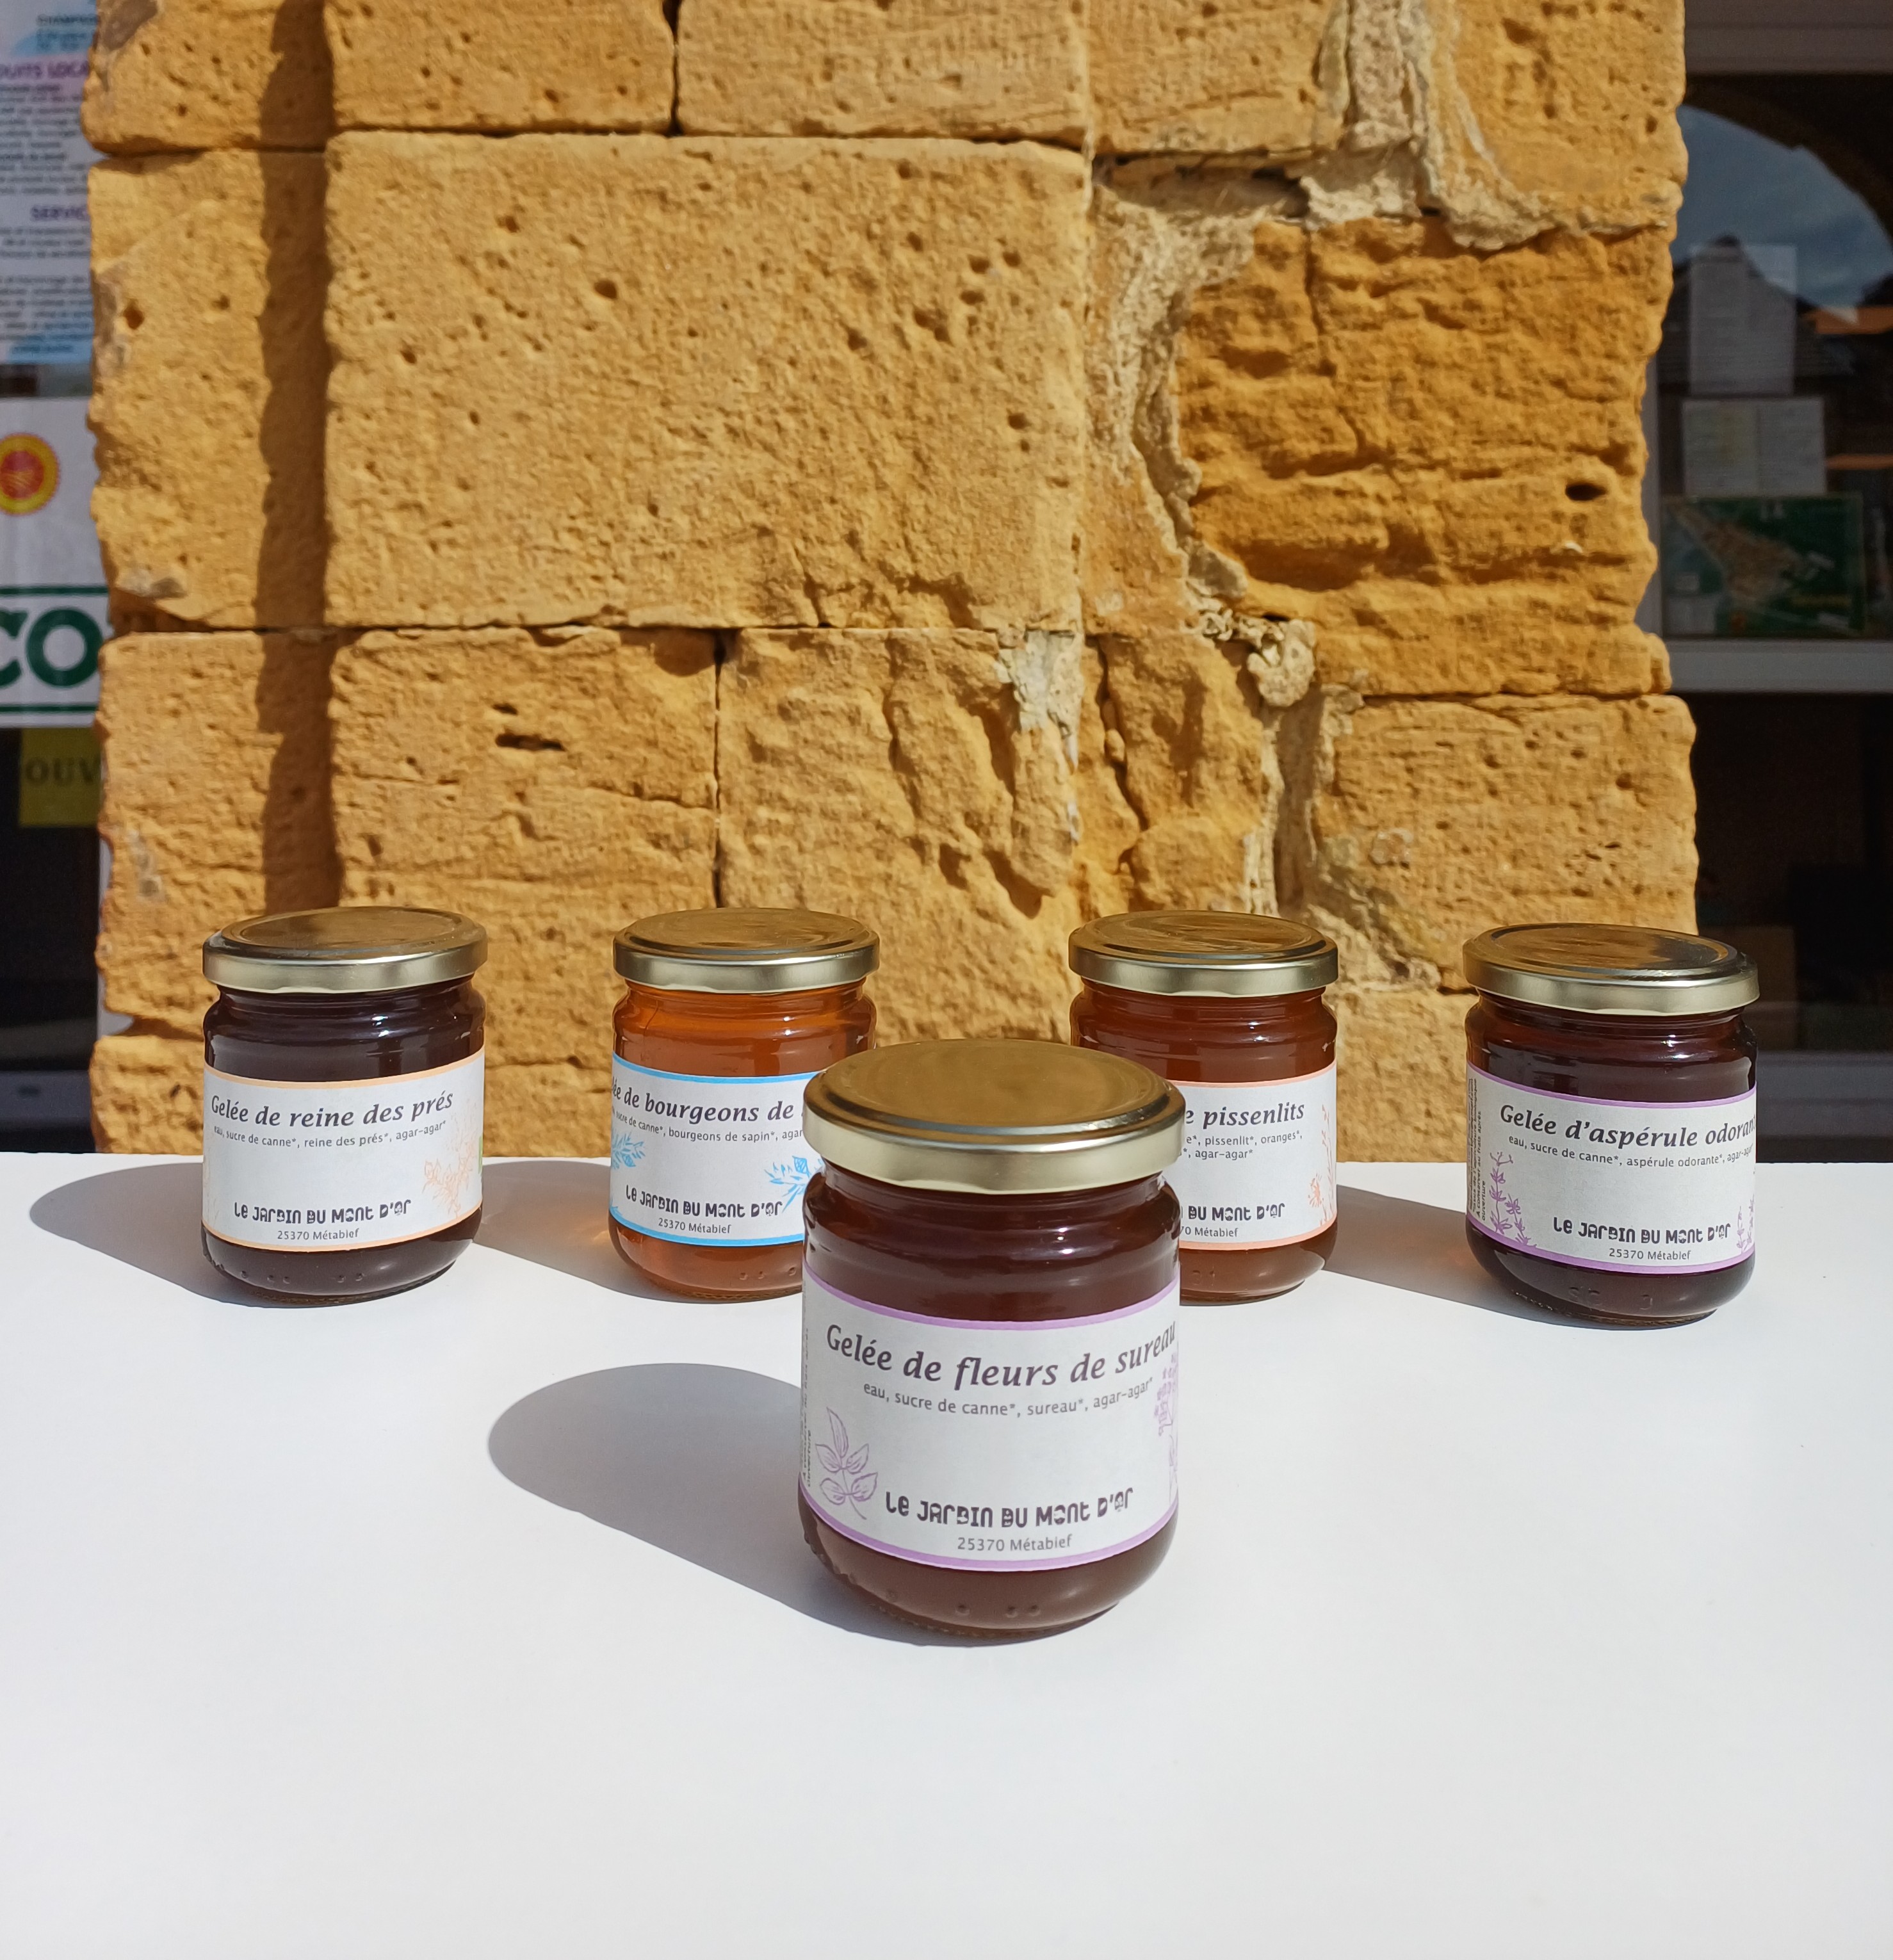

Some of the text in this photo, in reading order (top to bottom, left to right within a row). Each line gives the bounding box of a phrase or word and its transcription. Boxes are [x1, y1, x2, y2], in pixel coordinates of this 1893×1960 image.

[211, 1090, 453, 1127] Gelée de reine des prés
[624, 1087, 640, 1108] de
[645, 1092, 760, 1124] bourgeons
[768, 1101, 794, 1121] de
[1203, 1102, 1304, 1130] pissenlits
[226, 1130, 245, 1142] sucre
[248, 1134, 259, 1144] de
[304, 1138, 332, 1147] reine
[336, 1137, 355, 1146] des
[629, 1117, 637, 1127] de
[669, 1127, 721, 1142] bourgeons
[725, 1131, 737, 1142] de
[1500, 1105, 1556, 1134] Gelée
[1565, 1120, 1698, 1149] d'aspérule
[1509, 1135, 1527, 1149] eau,
[1531, 1142, 1557, 1155] sucre
[1562, 1148, 1575, 1158] de
[1627, 1157, 1674, 1168] aspérule
[277, 1228, 359, 1240] 25370 Métabief
[658, 1217, 732, 1234] 25370 Métabief
[1194, 1227, 1239, 1237] Métabief
[1609, 1248, 1691, 1260] 25370 Métabief
[827, 1324, 892, 1370] Gelée
[903, 1350, 941, 1381] de
[954, 1356, 1059, 1391] fleurs
[1069, 1352, 1105, 1383] de
[1115, 1321, 1175, 1374] sureau
[864, 1383, 890, 1402] eau,
[895, 1393, 932, 1410] sucre
[938, 1398, 956, 1413] de
[957, 1534, 1073, 1551] 25370 Métabief
